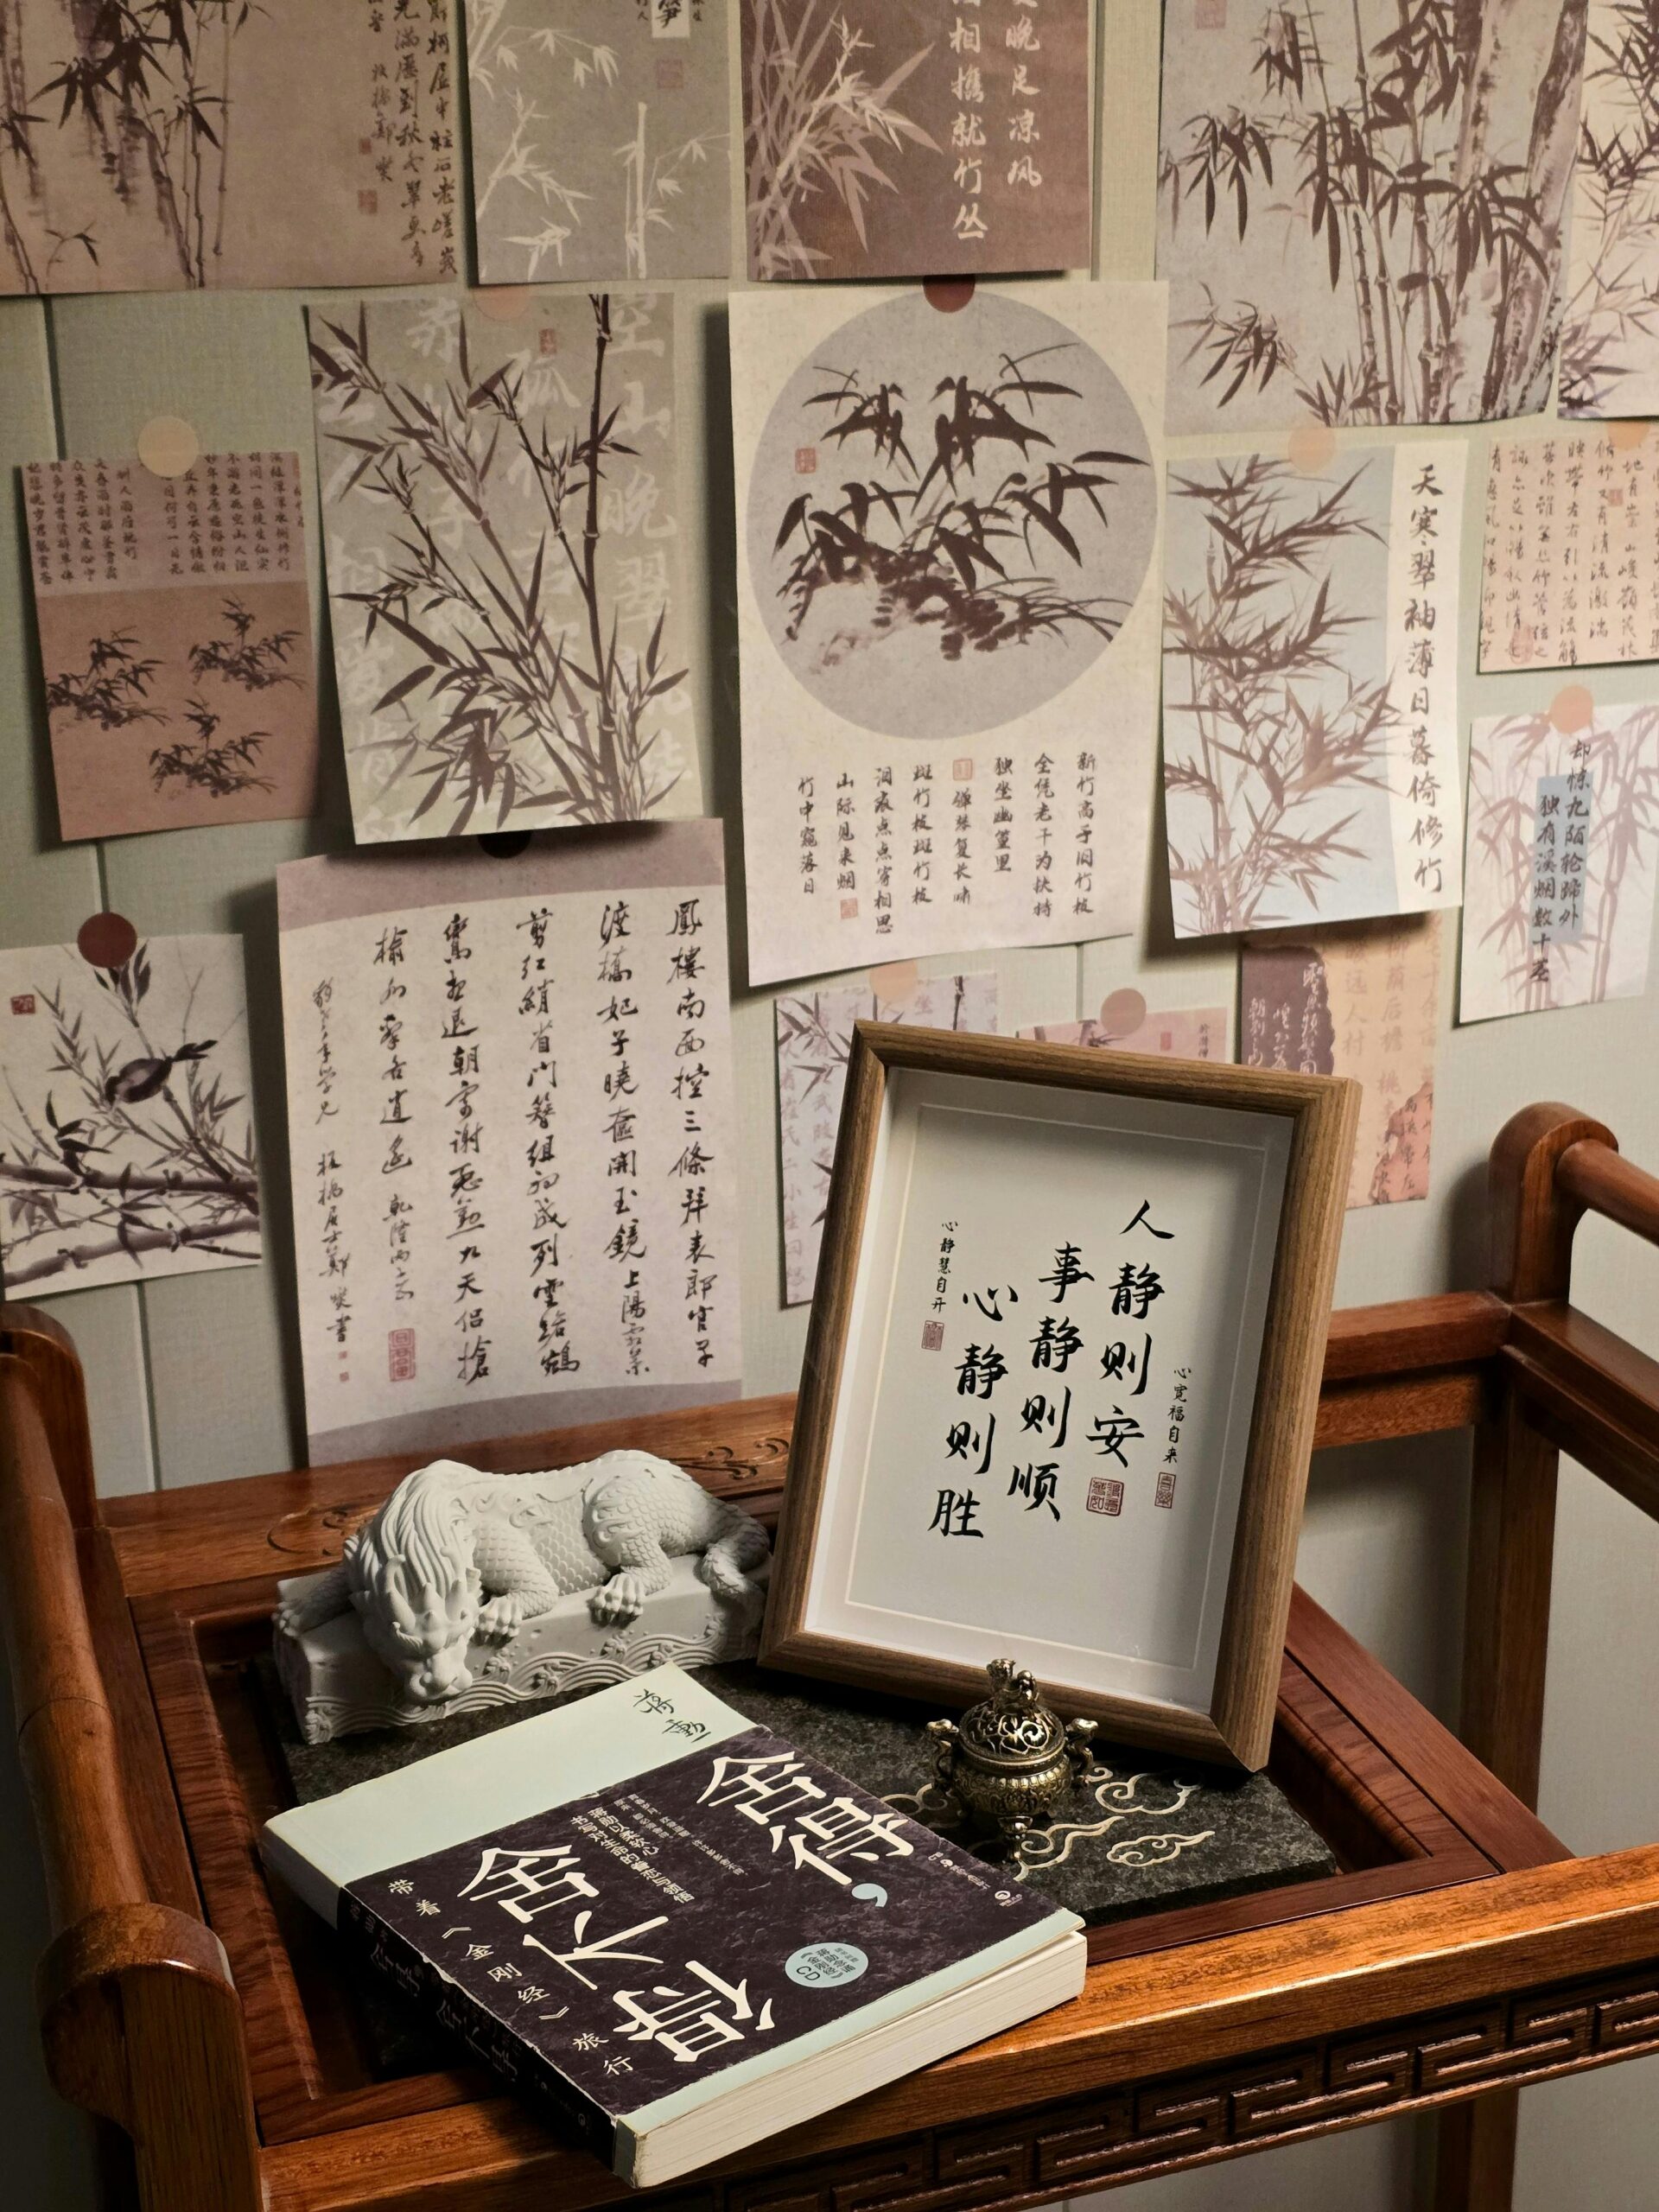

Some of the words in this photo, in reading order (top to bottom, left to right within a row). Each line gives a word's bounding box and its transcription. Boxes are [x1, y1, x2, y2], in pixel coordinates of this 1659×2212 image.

[1402, 463, 1444, 893] 天寒翠袖薄日暮倚修竹
[798, 777, 819, 894] 竹中窥落日
[836, 772, 856, 892] 山际见来烟
[874, 766, 894, 935] 泪痕点点寄相思
[912, 764, 933, 905] 斑竹枝斑竹枝
[951, 787, 973, 906] 弹琴复长啸
[994, 757, 1014, 873] 独坐幽篁里
[1033, 753, 1054, 918] 全凭老干为扶持
[1072, 752, 1096, 915] 新竹高于旧竹枝
[931, 1220, 959, 1313] 心静慧自开
[1085, 1198, 1175, 1469] 人静则安
[927, 1284, 1019, 1538] 心静则胜
[1007, 1241, 1095, 1522] 事静则顺
[1162, 1367, 1192, 1465] 心宽福自来
[570, 1815, 695, 1904] 书写对生命的眷恋与领悟
[588, 1806, 659, 1856] 蒋勋以柔软心
[388, 1878, 634, 2075] 带着《金刚经》旅行
[456, 1846, 776, 2063] 舍不得
[796, 1966, 821, 1980] CD
